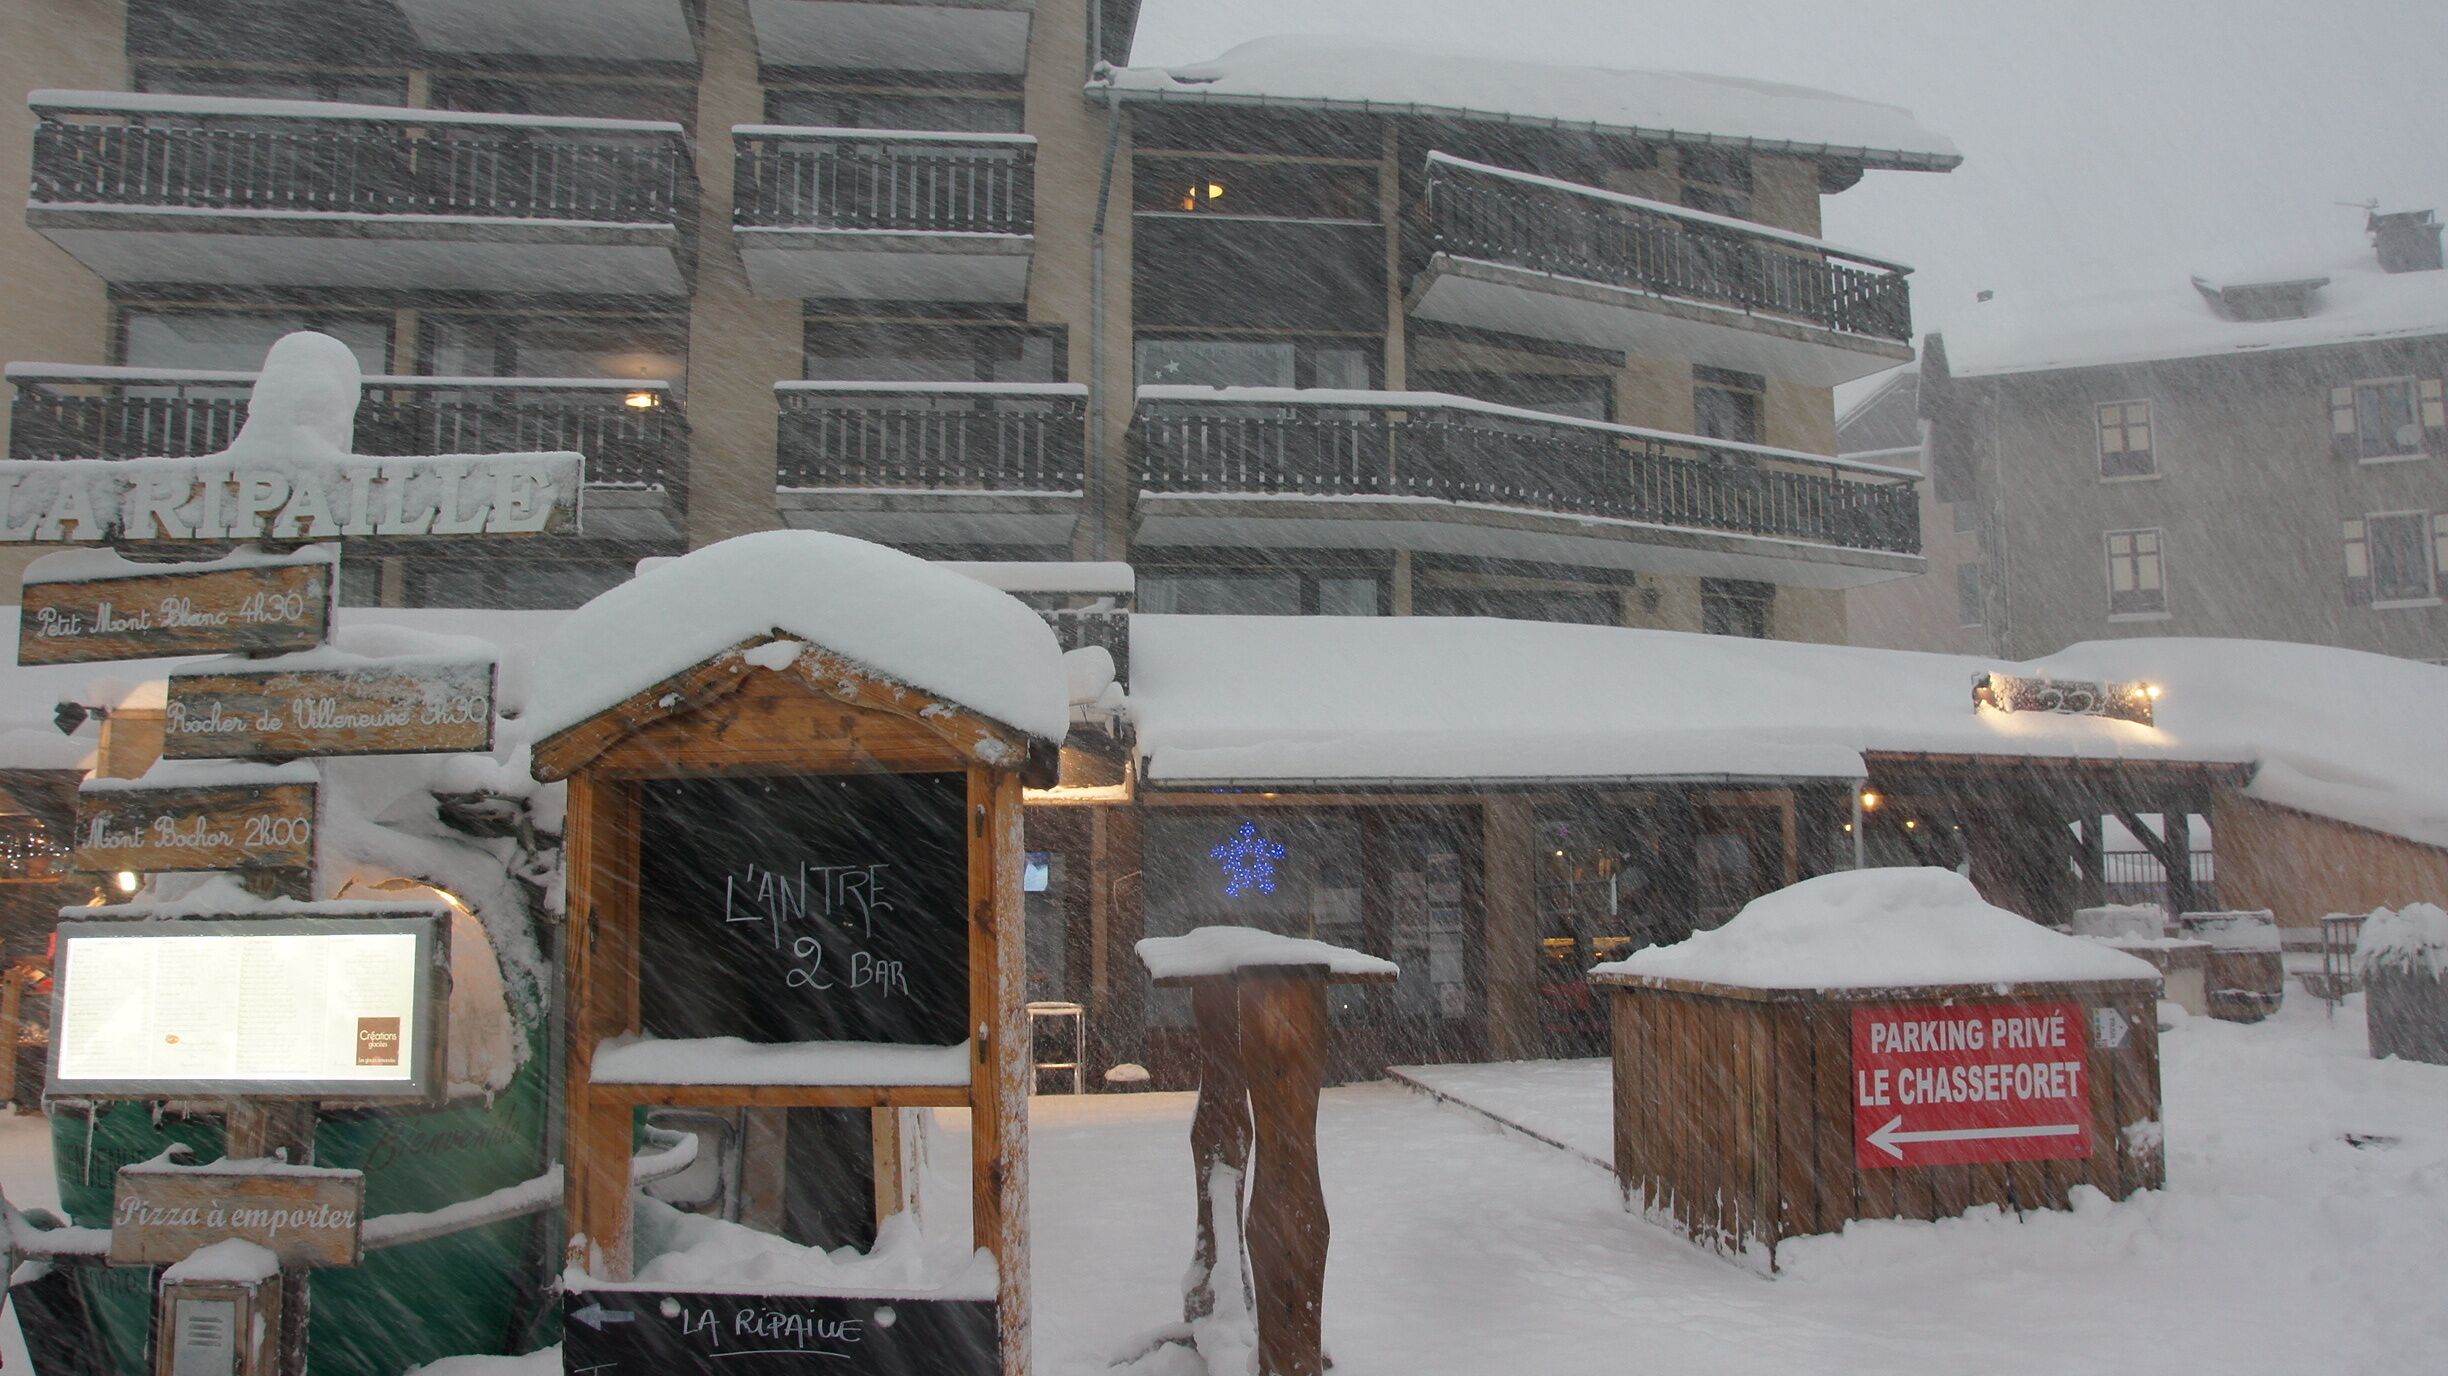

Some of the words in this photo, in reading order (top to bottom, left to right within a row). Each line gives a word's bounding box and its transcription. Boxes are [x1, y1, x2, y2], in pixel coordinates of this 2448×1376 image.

[124, 464, 553, 540] RIPAILLE
[36, 606, 81, 637] Petit
[90, 602, 150, 634] Mont
[160, 597, 229, 628] Blanc
[239, 592, 304, 623] 4h30
[166, 700, 248, 734] Rocher
[256, 710, 283, 732] de
[292, 697, 410, 730] Villeneuve
[82, 816, 145, 849] Mont
[154, 815, 234, 847] Bochor
[245, 815, 312, 846] 2h00
[725, 861, 894, 949] L'ANTRE
[786, 936, 834, 990] 2
[850, 951, 909, 998] BAR
[1870, 1018, 1985, 1053] PARKING
[1991, 1009, 2067, 1049] PRIVÉ
[1858, 1069, 1891, 1107] LE
[1898, 1061, 2081, 1106] CHASSEFORET
[115, 1196, 201, 1226] Pizza
[206, 1200, 227, 1228] à
[231, 1203, 357, 1237] emporter
[683, 1308, 720, 1347] LA
